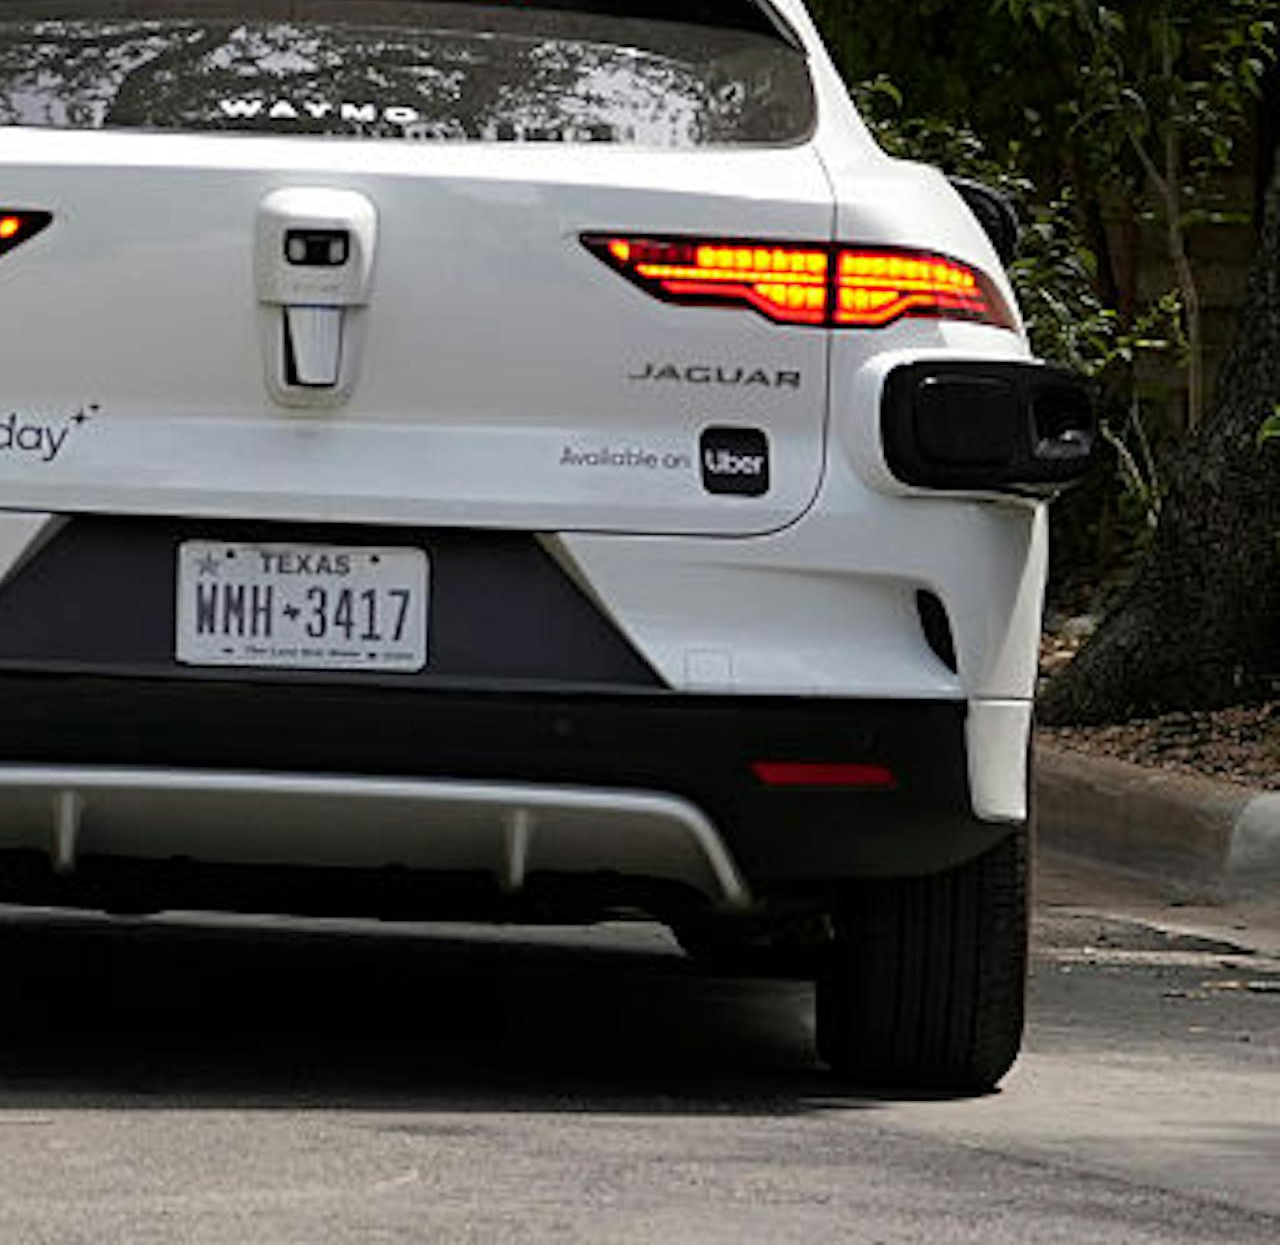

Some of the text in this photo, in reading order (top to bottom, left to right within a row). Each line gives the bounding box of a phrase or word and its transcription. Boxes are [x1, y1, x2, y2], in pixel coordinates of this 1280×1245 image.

[218, 99, 420, 125] WAYMO
[627, 363, 802, 388] JAGUAR
[704, 447, 766, 476] Uber
[260, 553, 351, 577] TEXAS
